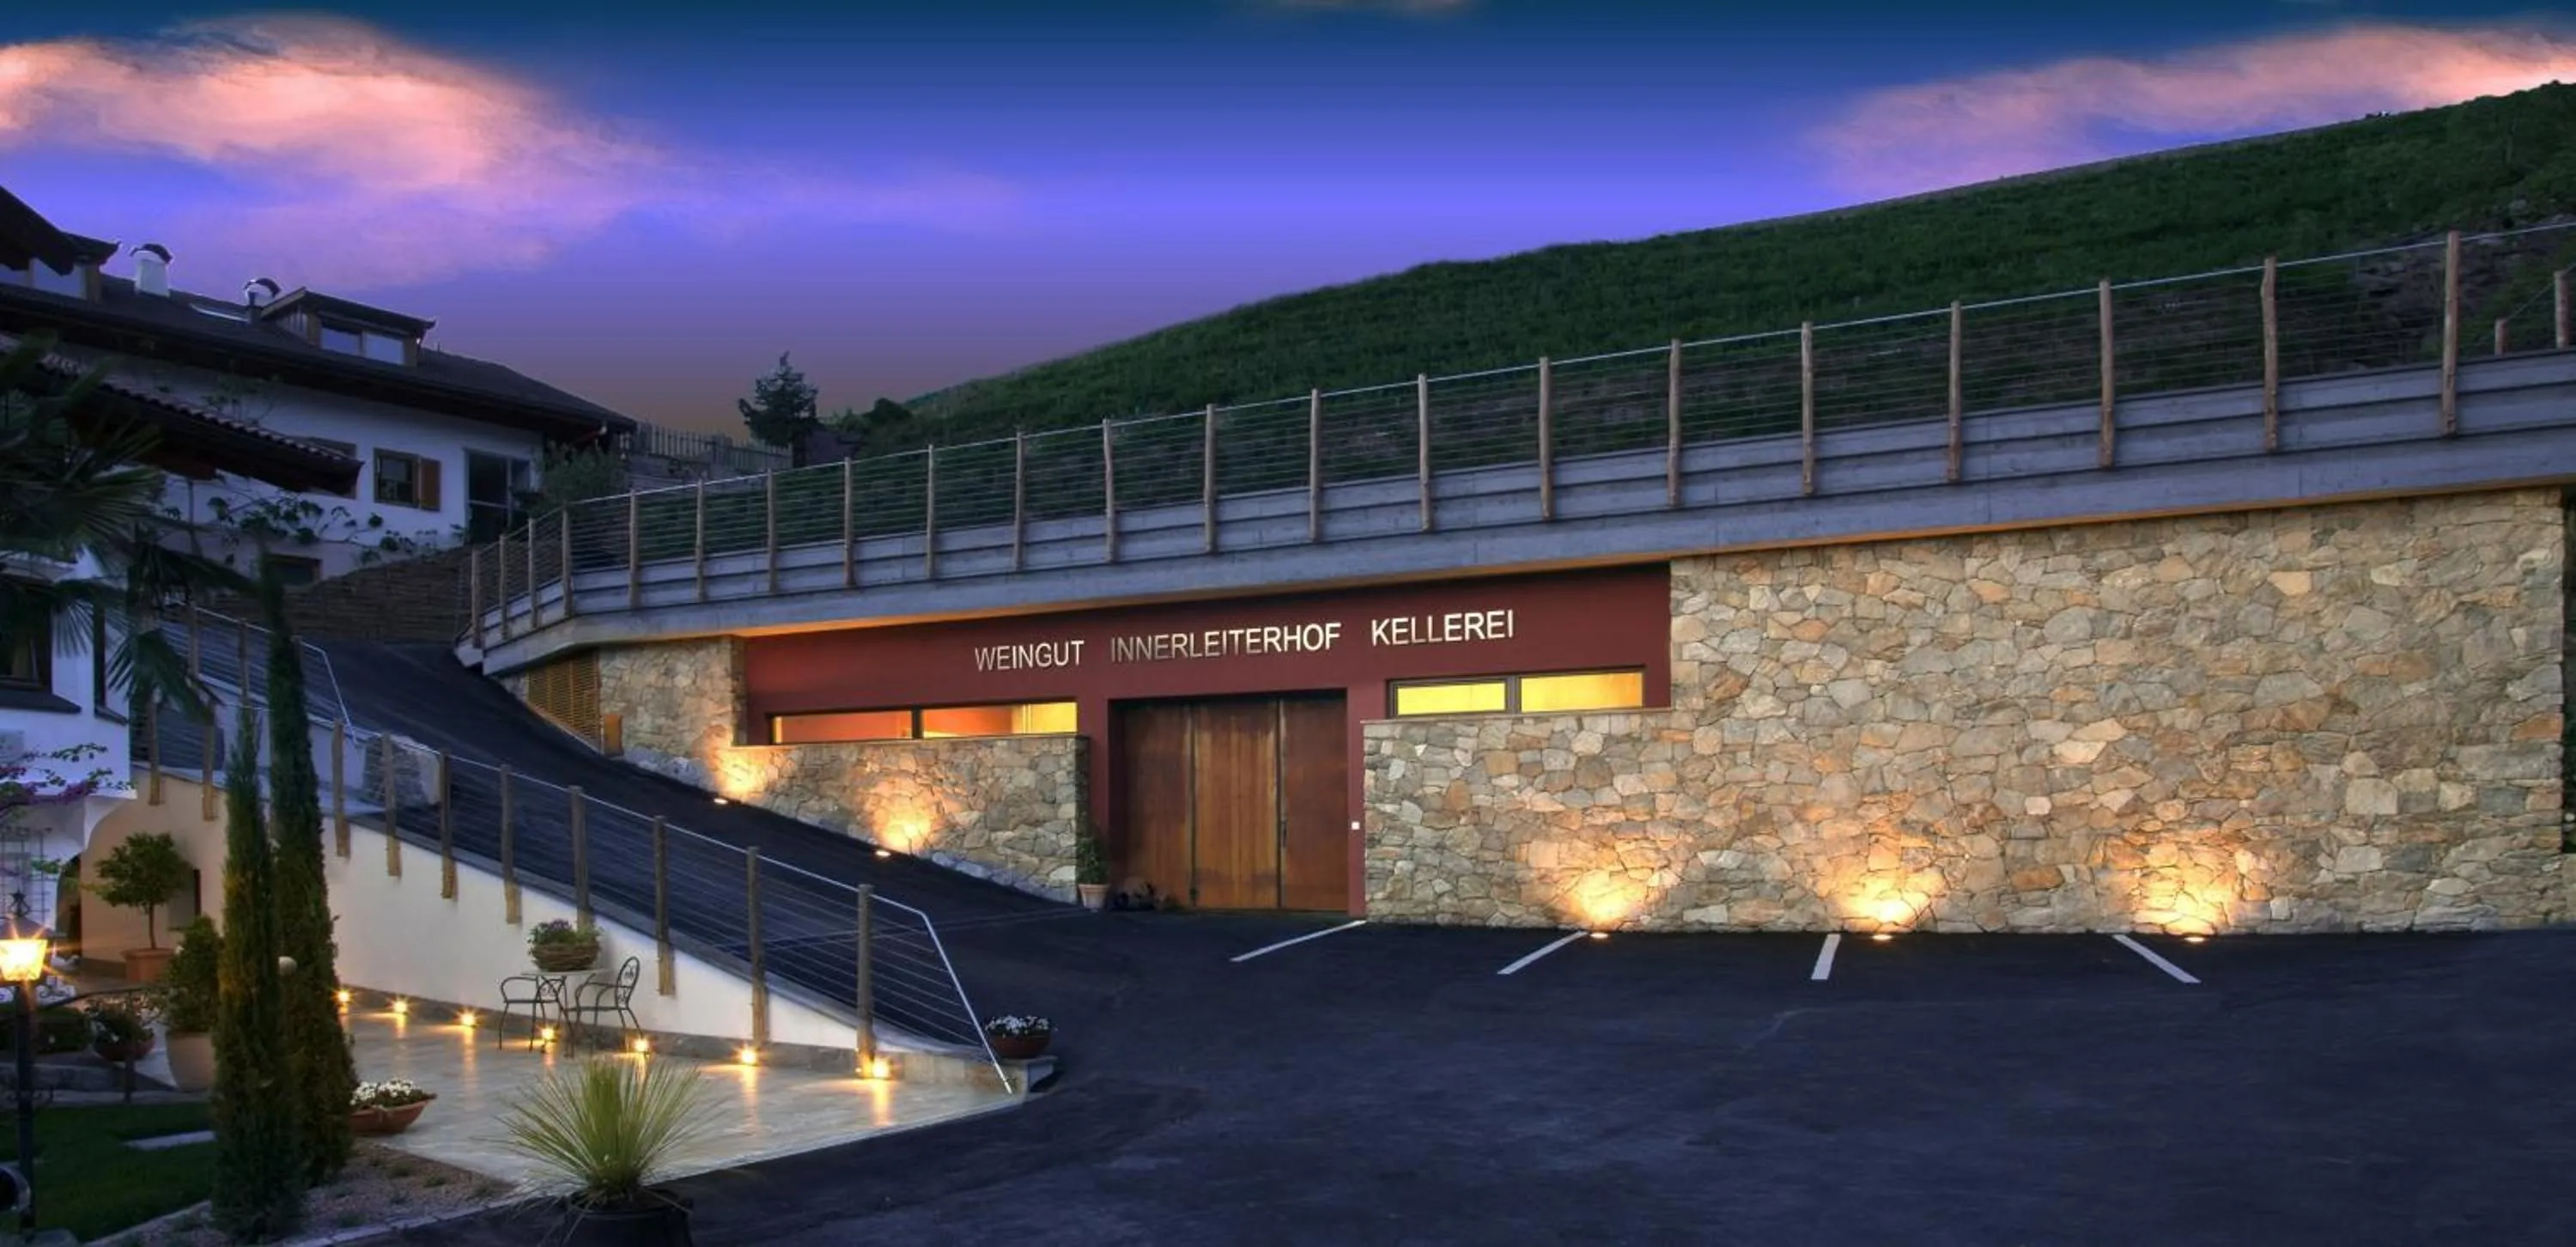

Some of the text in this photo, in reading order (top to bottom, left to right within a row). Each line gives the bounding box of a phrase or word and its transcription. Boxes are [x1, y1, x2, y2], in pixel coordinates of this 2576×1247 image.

[975, 609, 1515, 672] WEINGUT INNERLEITERHOF KELLEREI
